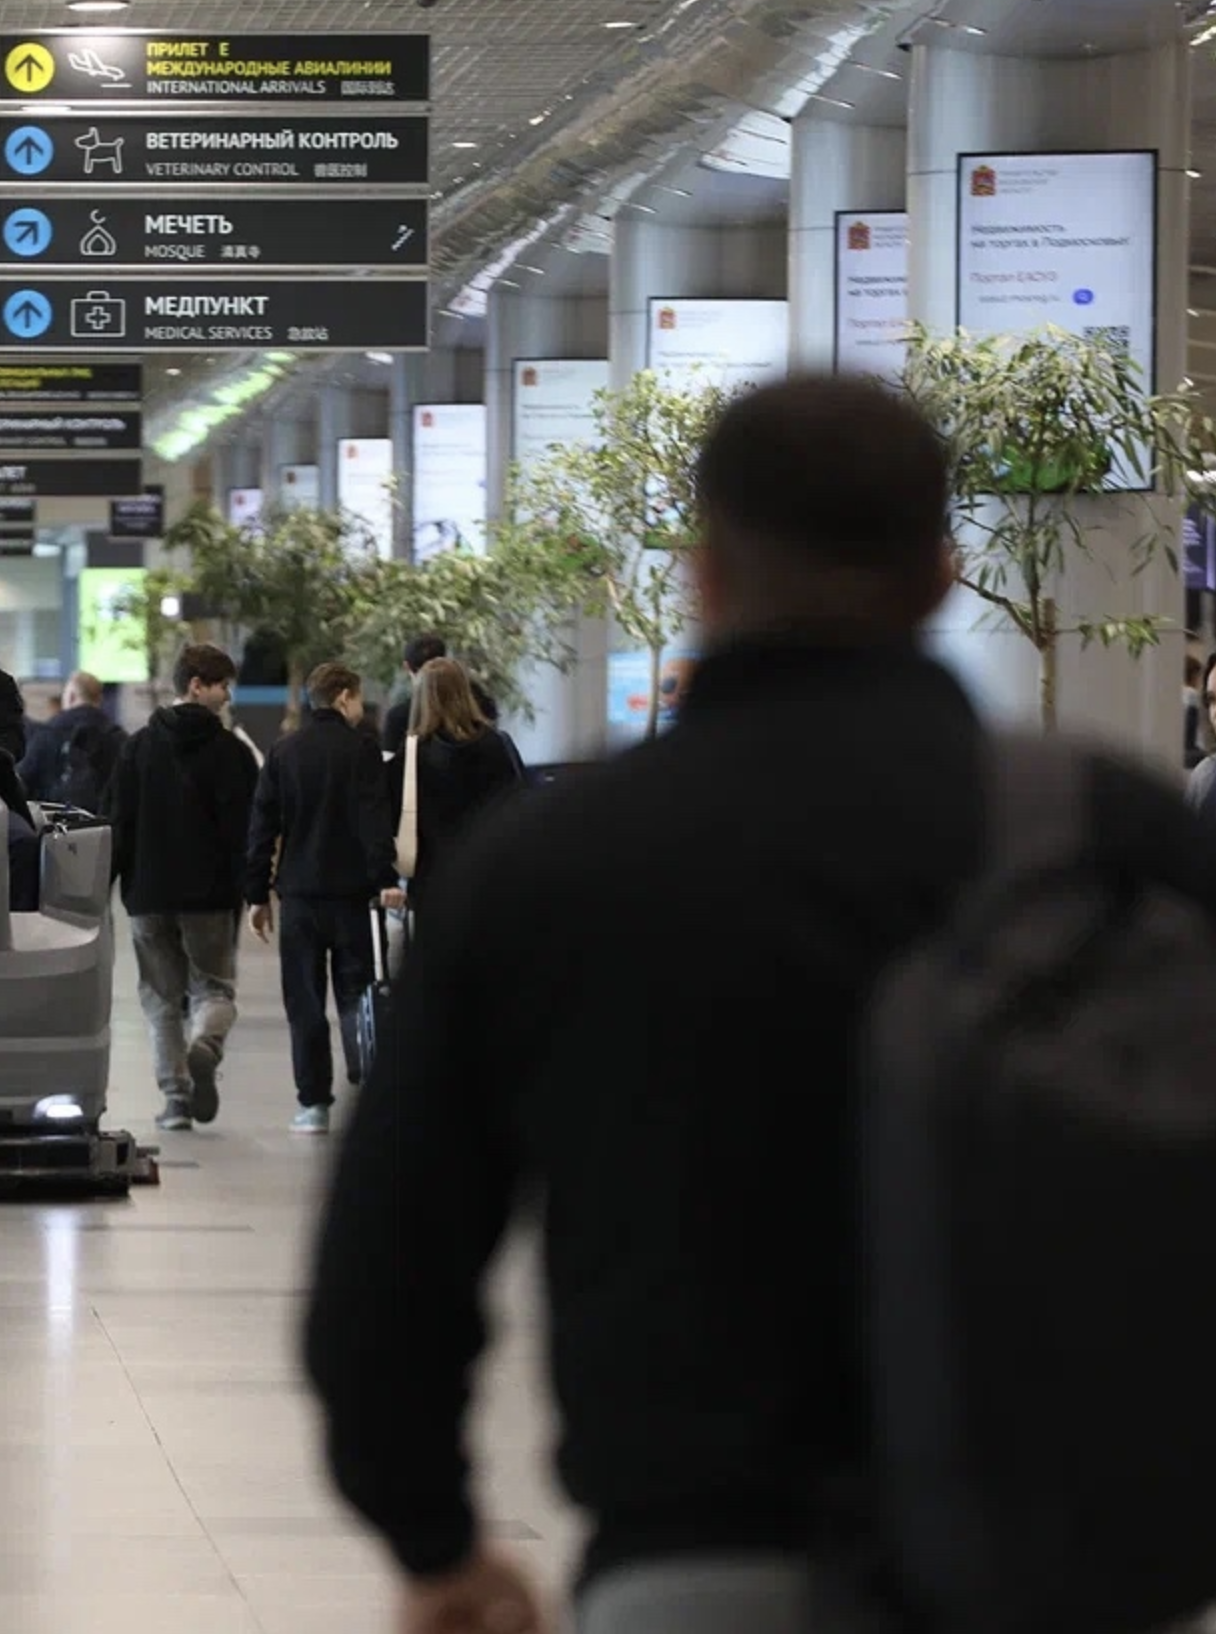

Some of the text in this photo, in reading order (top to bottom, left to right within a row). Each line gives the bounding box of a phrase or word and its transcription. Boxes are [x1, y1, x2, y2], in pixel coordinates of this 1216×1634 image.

[147, 42, 208, 57] ПРИЛЕТ
[147, 61, 392, 77] МЕЖДУНАРОДНЫЕ АВИАЛИНИИ
[147, 80, 256, 95] INTERNATIONAL
[257, 80, 326, 95] ARRIVALS
[146, 129, 399, 149] ВЕТЕРИНАРНЫЙ КОНТРОЛЬ
[146, 163, 230, 177] VETERINARY
[232, 163, 299, 177] CONTROL
[144, 215, 233, 234] МЕЧЕТЬ
[144, 244, 206, 260] MOSQUE
[144, 297, 269, 318] МЕДПУНКТ
[144, 326, 207, 341] MEDICAL
[208, 326, 273, 341] SERVICES
